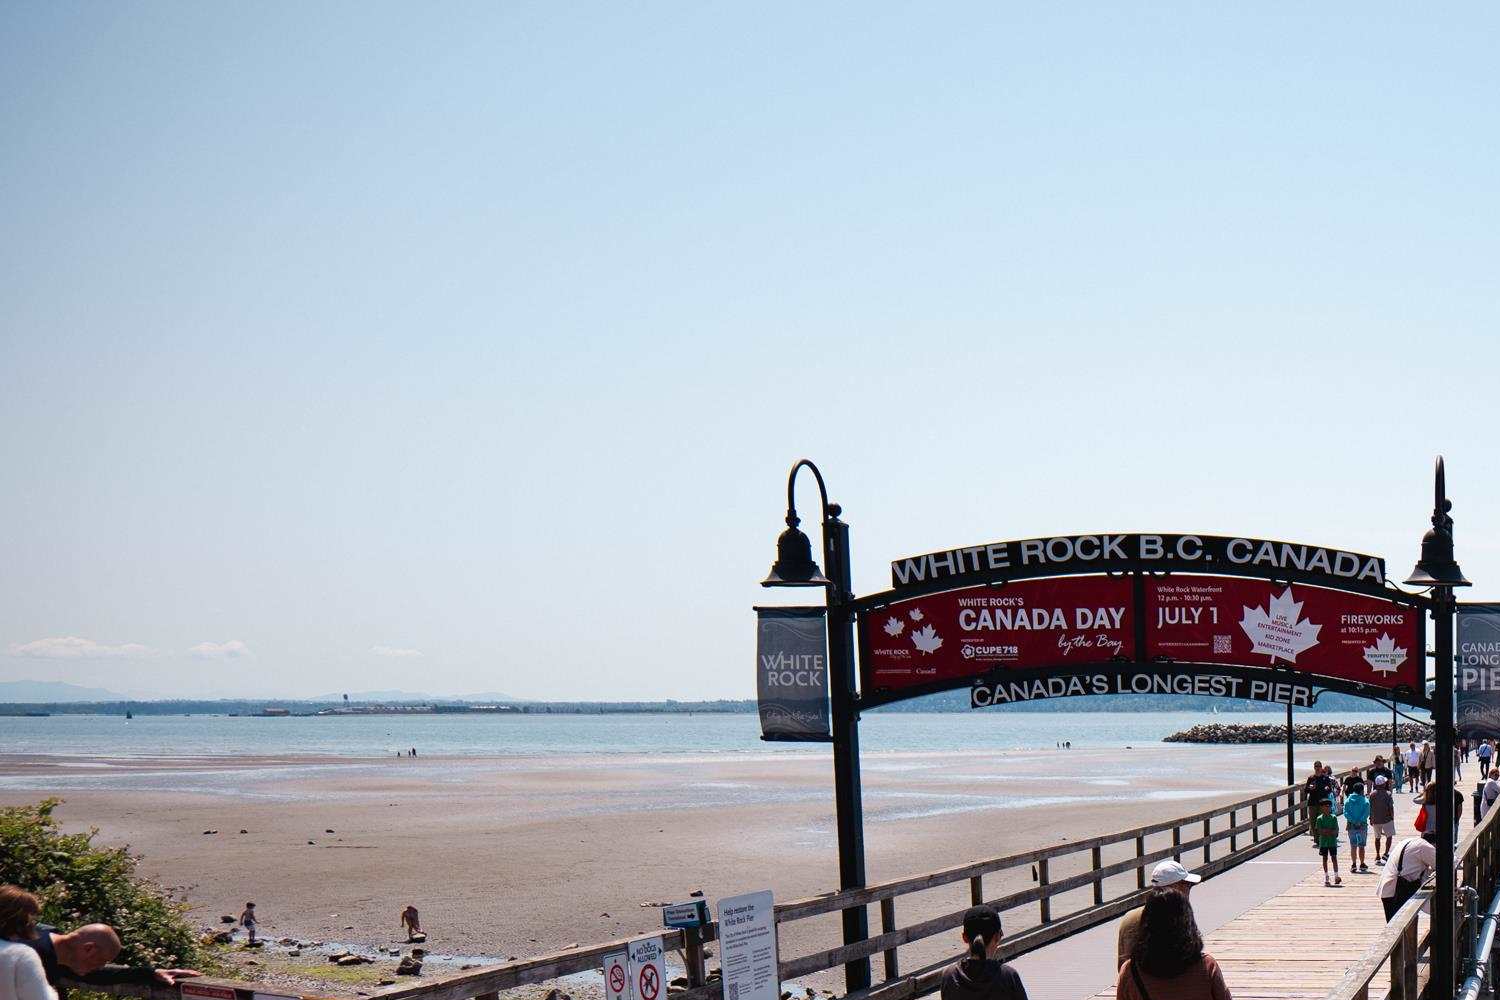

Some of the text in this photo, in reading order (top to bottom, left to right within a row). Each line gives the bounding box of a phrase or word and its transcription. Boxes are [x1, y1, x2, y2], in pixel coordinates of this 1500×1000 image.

[892, 535, 1384, 585] WHITE ROCK B.C. CANADA
[958, 597, 1024, 607] WHITE ROCK'S
[958, 607, 1126, 631] CANADA DAY
[1157, 607, 1218, 629] JULY 1
[1276, 614, 1287, 622] LIVE
[1341, 614, 1404, 625] FIREWORKS
[1257, 622, 1302, 638] ENTERTAINMENT
[975, 646, 1018, 654] CUPE 718
[1058, 634, 1123, 656] by the Bay
[1258, 641, 1295, 655] MARKETPLACE
[762, 651, 824, 670] WHITE
[768, 671, 821, 687] ROCK
[973, 674, 1309, 707] CANADA'S LONGEST PIER
[723, 908, 735, 917] Help
[724, 918, 736, 926] White
[737, 916, 745, 924] Rock
[636, 944, 656, 955] NO DOGS
[637, 953, 656, 963] ALLOWED
